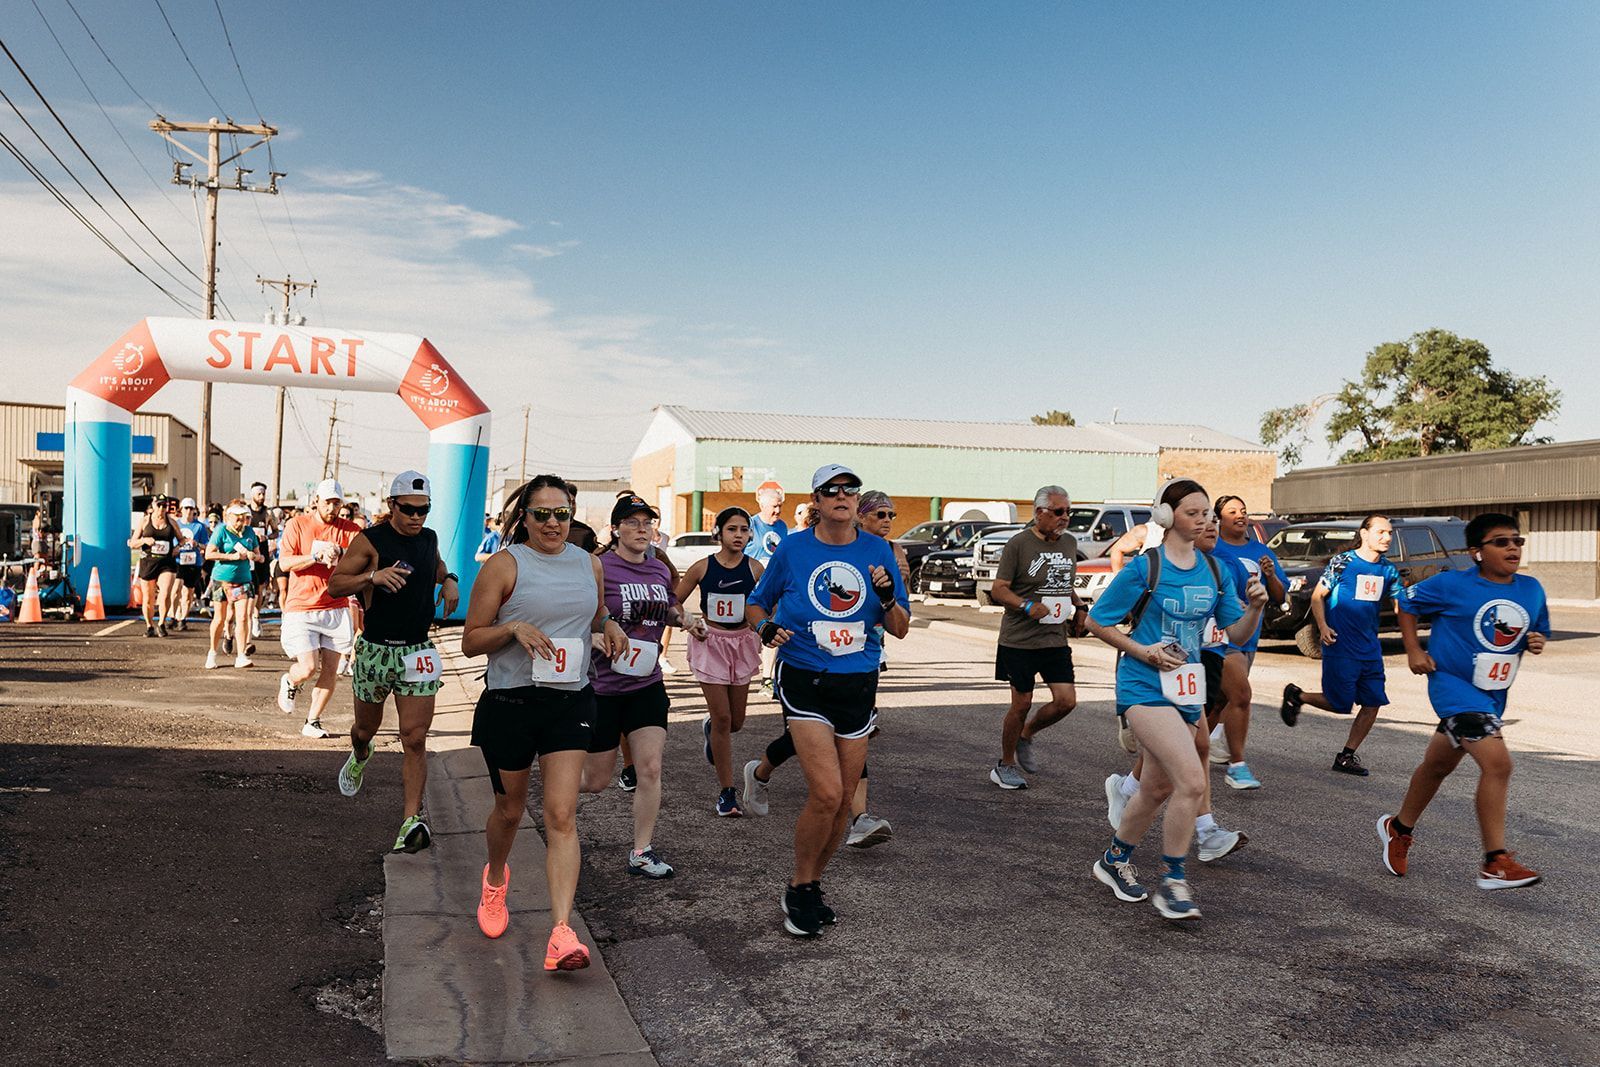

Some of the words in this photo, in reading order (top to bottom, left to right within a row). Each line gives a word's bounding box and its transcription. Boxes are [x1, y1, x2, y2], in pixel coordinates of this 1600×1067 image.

[206, 328, 364, 377] START
[100, 376, 117, 385] IT'S
[121, 378, 154, 386] ABOUT
[411, 395, 425, 405] IT'S
[428, 398, 459, 408] ABOUT
[619, 583, 651, 601] RUN
[1364, 580, 1377, 595] 94
[716, 600, 734, 617] 61
[1054, 603, 1062, 618] 3
[415, 655, 435, 674] 45
[555, 647, 567, 673] 9
[629, 647, 642, 667] 7
[1488, 662, 1511, 681] 49
[1176, 673, 1197, 696] 16
